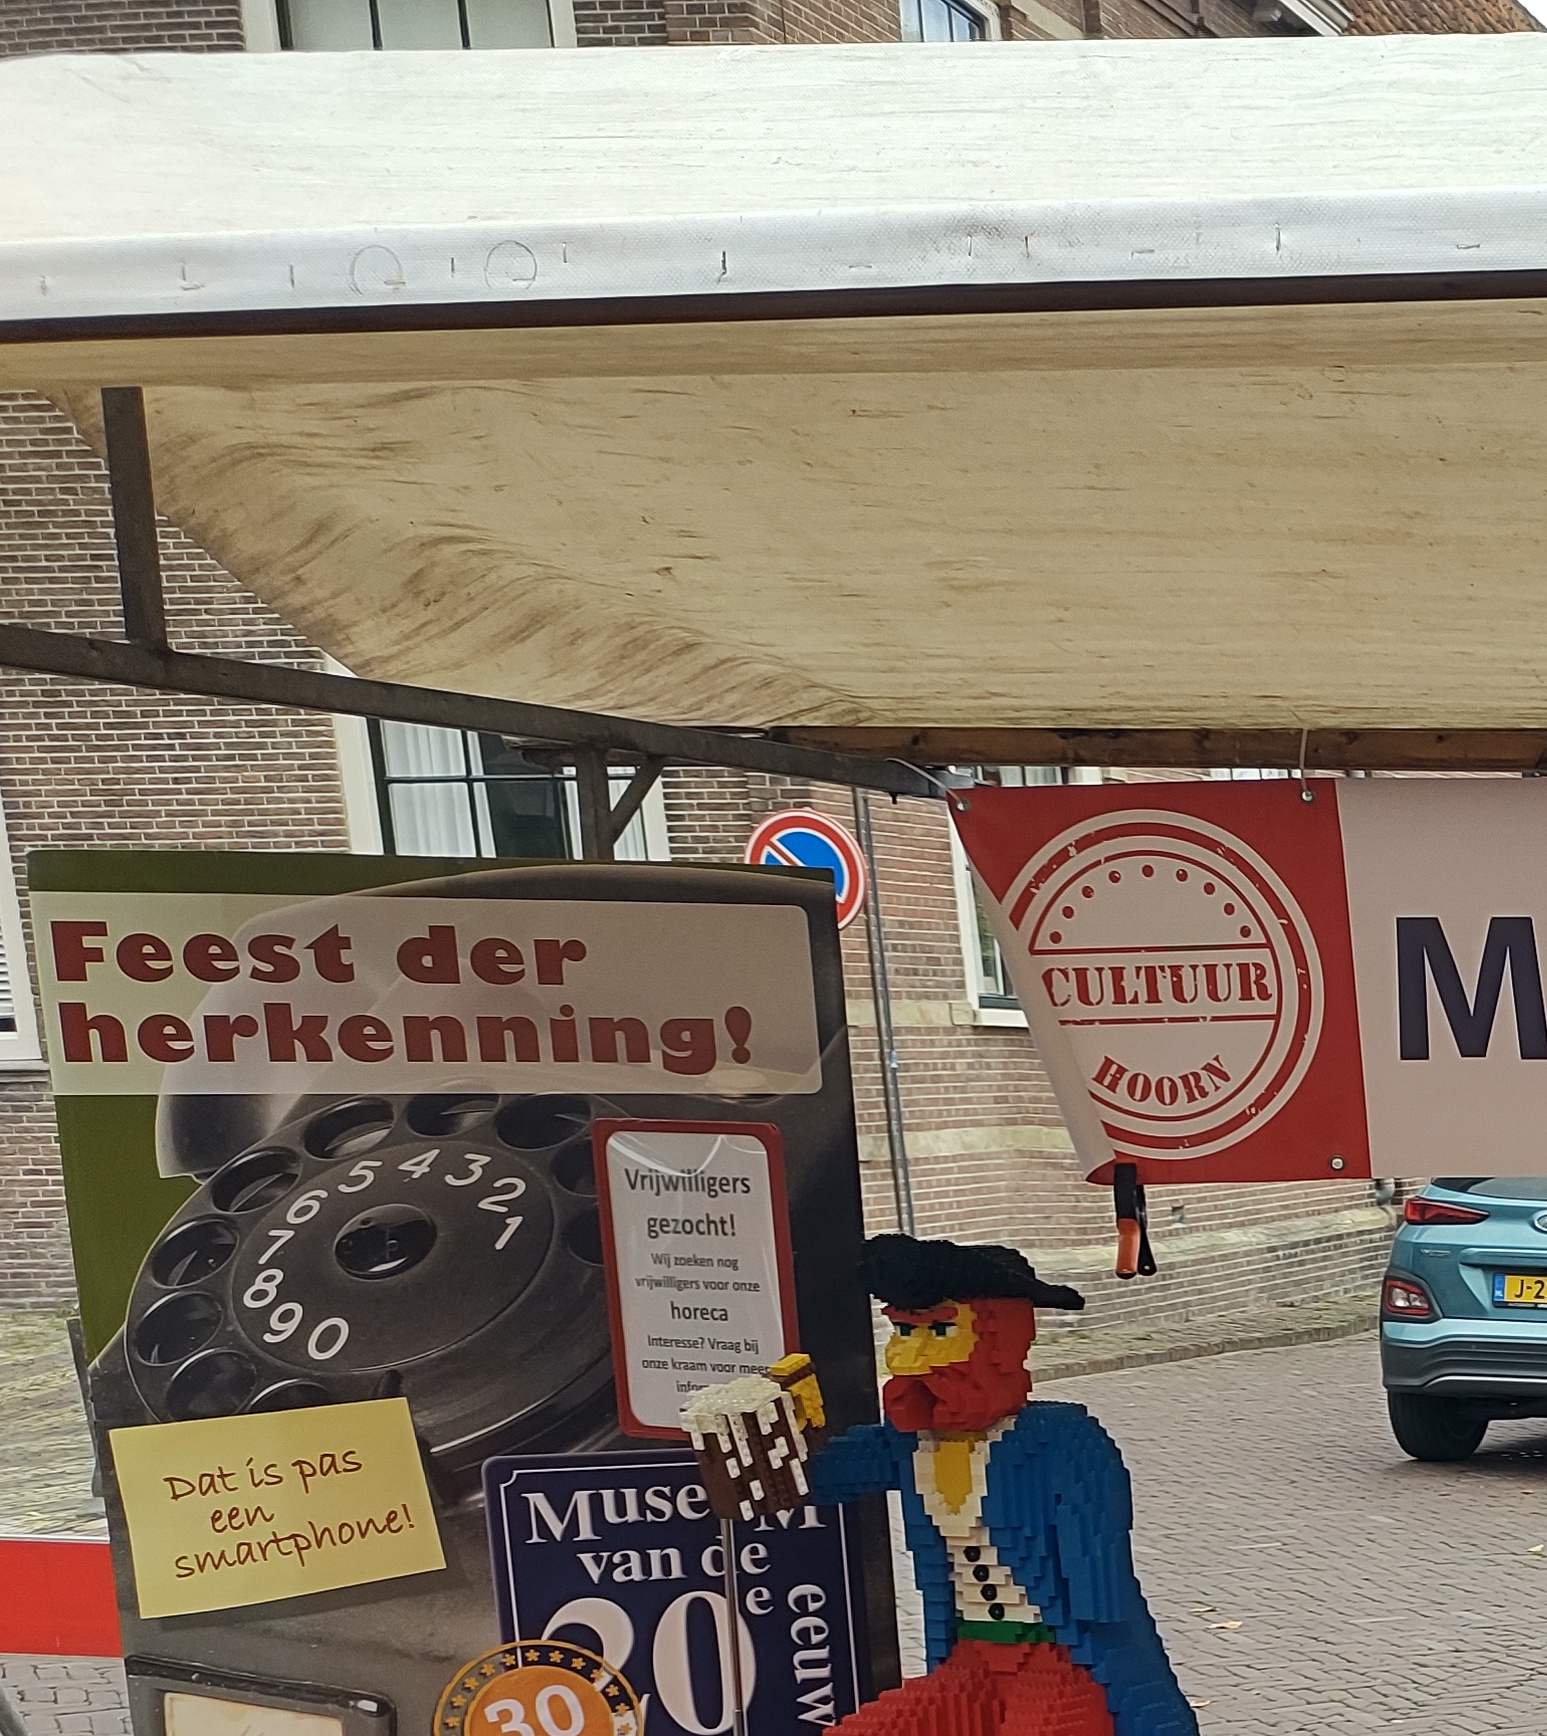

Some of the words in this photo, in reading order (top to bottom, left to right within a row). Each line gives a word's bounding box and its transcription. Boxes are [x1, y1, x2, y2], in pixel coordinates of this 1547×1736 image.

[51, 920, 354, 983] Feest
[396, 925, 587, 986] der
[1041, 961, 1272, 1008] CULTUUR
[63, 1002, 753, 1076] herkenning!
[1091, 1054, 1232, 1106] HOORN
[624, 1168, 751, 1198] Vrijwilligers
[647, 1213, 737, 1238] gezocht!
[651, 1252, 671, 1268] Wij
[673, 1254, 714, 1267] zoeken
[717, 1257, 739, 1271] nog
[635, 1275, 700, 1292] vrijwilligers
[702, 1279, 730, 1291] voor
[732, 1281, 760, 1292] onze
[670, 1301, 729, 1322] horeca
[647, 1335, 705, 1350] Interesse?
[707, 1338, 741, 1352] Vraag
[743, 1338, 759, 1355] bij
[641, 1358, 669, 1370] onze
[671, 1358, 707, 1372] kraam
[710, 1361, 737, 1373] voor
[163, 1466, 239, 1501] Dat
[246, 1457, 283, 1488] is
[292, 1450, 362, 1493] pas
[211, 1505, 274, 1533] een
[175, 1504, 414, 1578] smartphone!
[577, 1543, 687, 1584] van
[701, 1535, 773, 1577] de
[787, 1584, 837, 1726] eeuw
